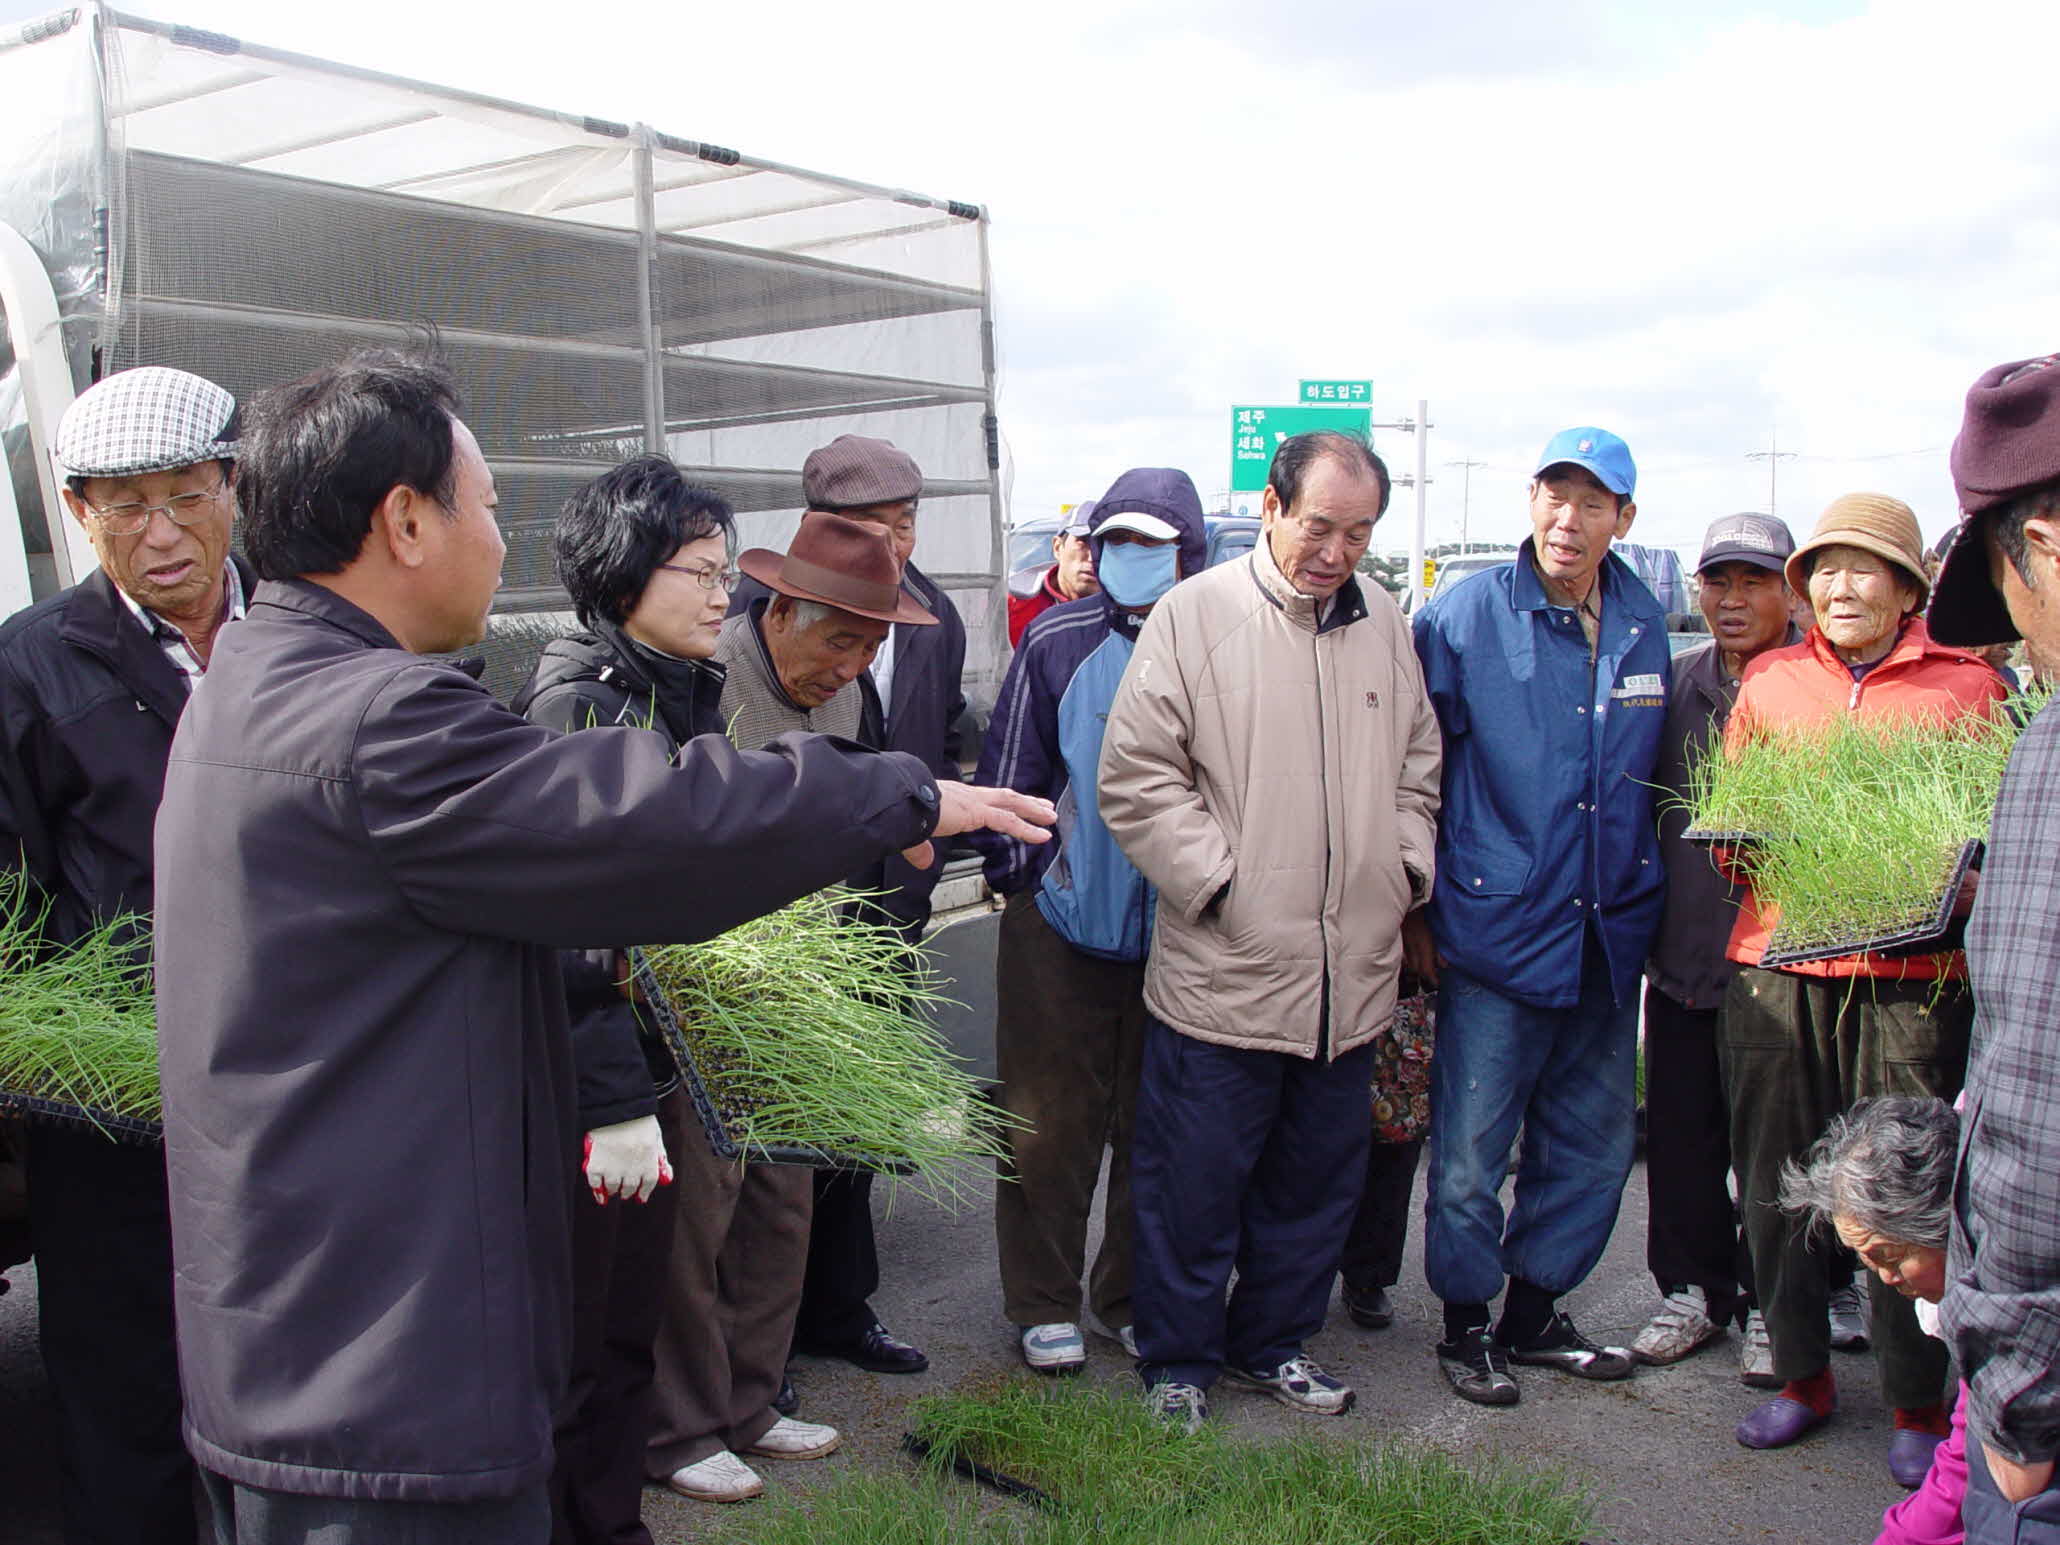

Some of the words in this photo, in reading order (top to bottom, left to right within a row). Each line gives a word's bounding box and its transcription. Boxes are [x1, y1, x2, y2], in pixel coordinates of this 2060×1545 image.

[1306, 384, 1365, 400] 하도입구
[1237, 409, 1266, 424] 제주
[1237, 436, 1265, 450] 세화
